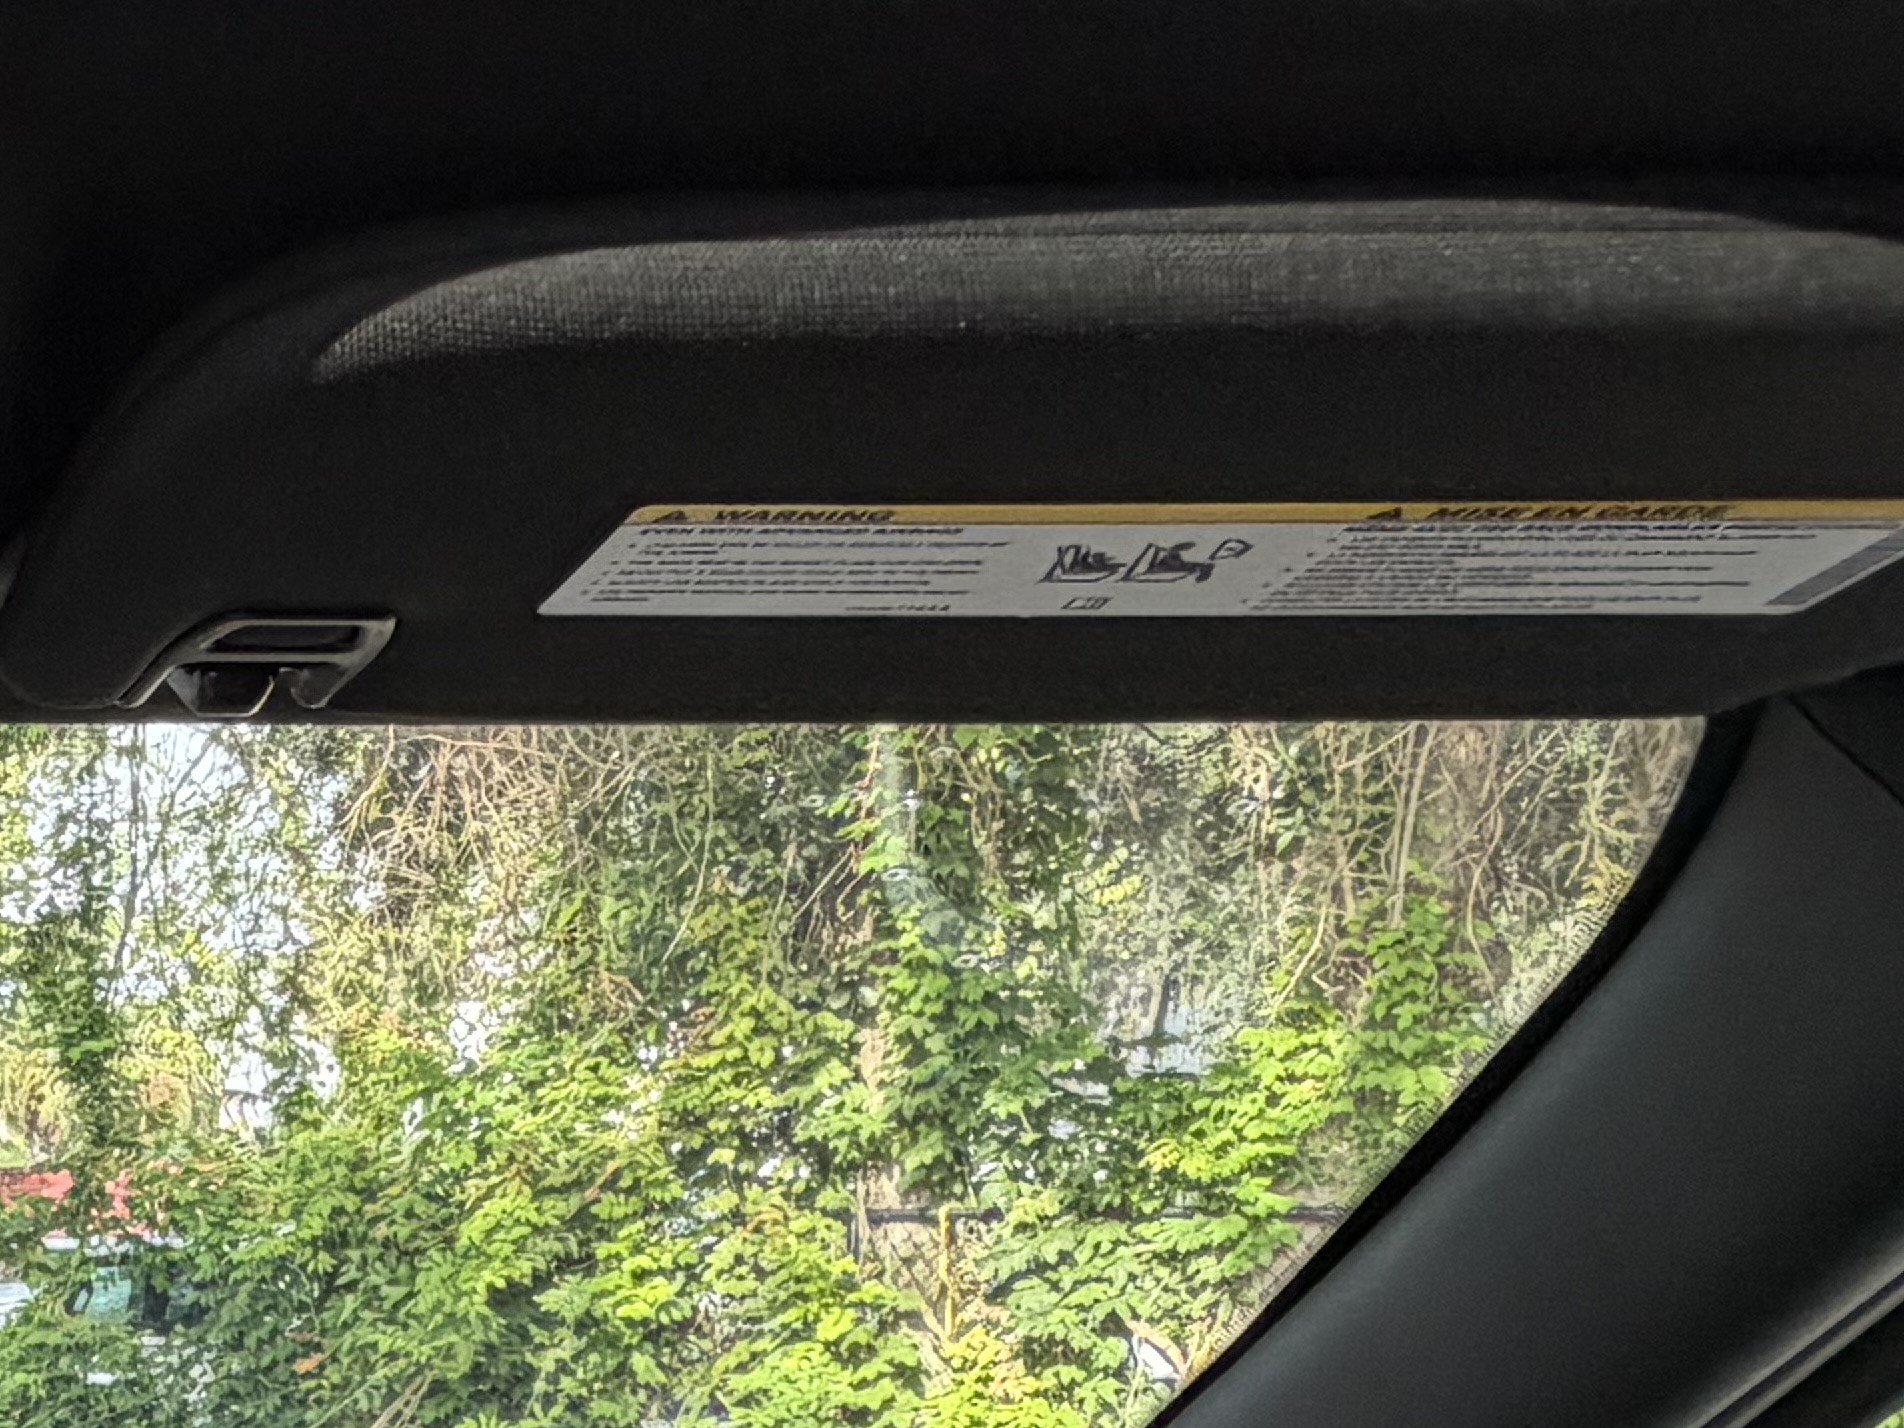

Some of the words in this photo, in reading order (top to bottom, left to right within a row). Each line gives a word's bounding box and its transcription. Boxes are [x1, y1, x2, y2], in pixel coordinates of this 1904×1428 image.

[716, 509, 896, 522] WARNING
[1427, 505, 1517, 521] MISE
[1532, 505, 1586, 521] EN
[1594, 505, 1730, 520] GARDE
